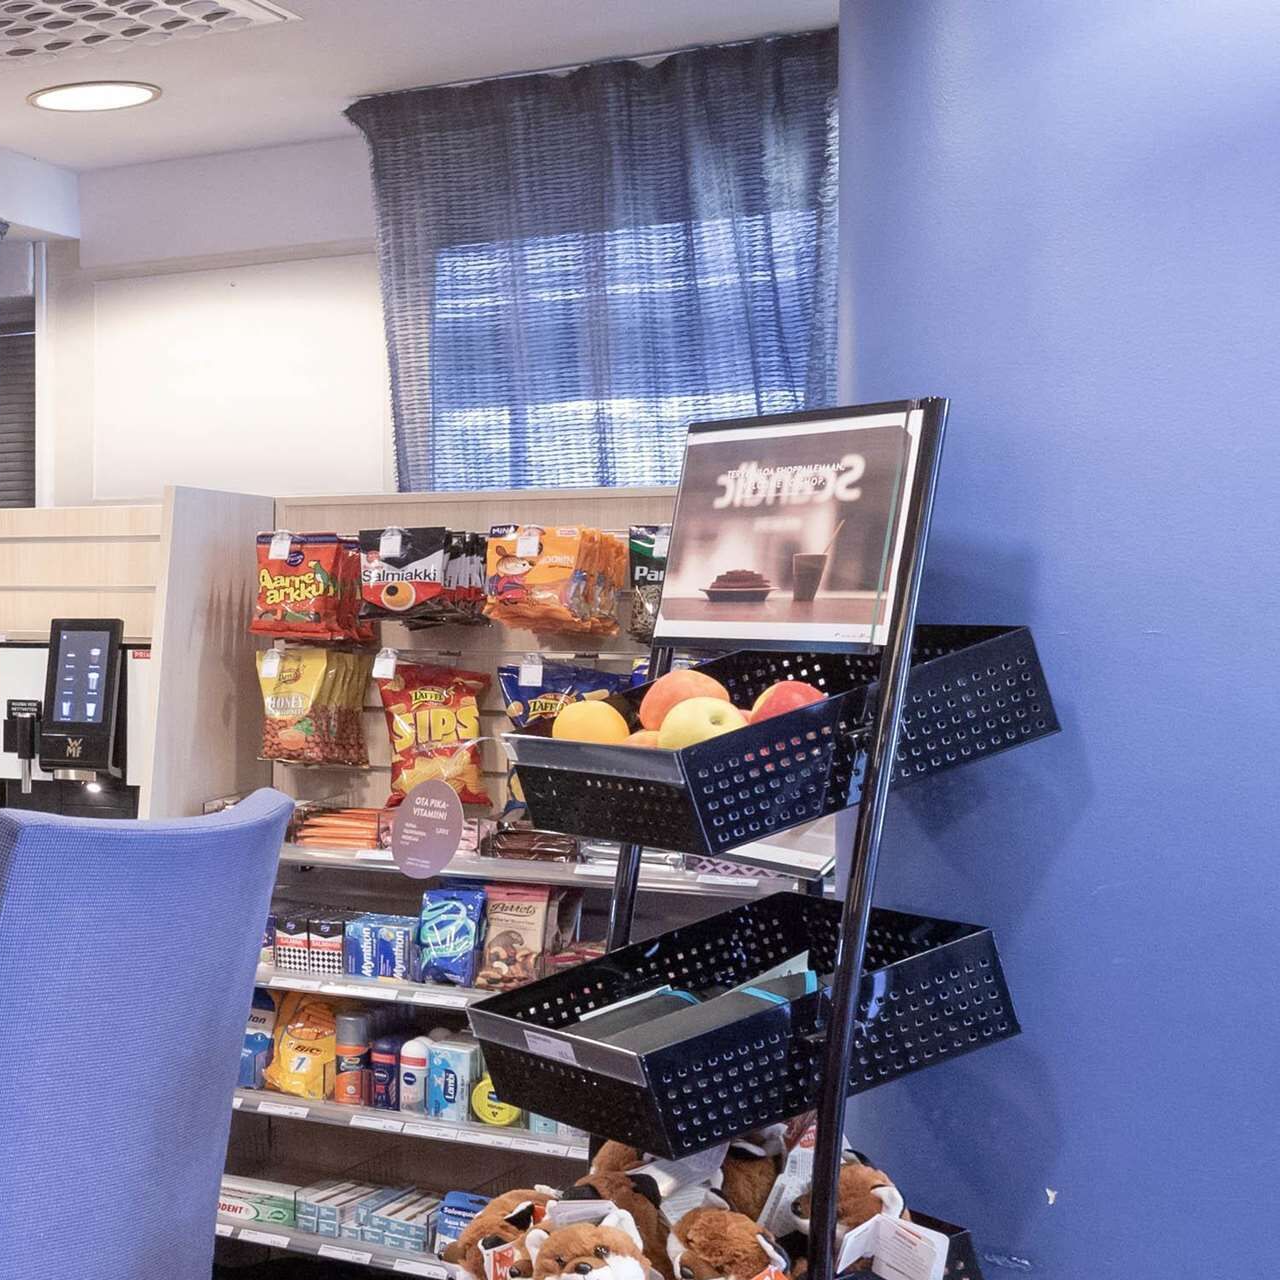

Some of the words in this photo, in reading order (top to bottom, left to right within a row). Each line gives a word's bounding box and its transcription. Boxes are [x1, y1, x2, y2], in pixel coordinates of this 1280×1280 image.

[259, 568, 315, 593] Aarre
[362, 568, 437, 583] Salmiakki
[266, 582, 324, 606] arkku
[392, 704, 480, 754] SIPS
[412, 807, 448, 821] VITAMIINI
[415, 796, 429, 807] OTA
[429, 798, 450, 809] PIKA-
[361, 927, 375, 977] Mynthon
[392, 930, 406, 980] Mynthon
[295, 1044, 322, 1056] BIC
[295, 1056, 307, 1071] 1
[445, 1072, 455, 1099] Lambi
